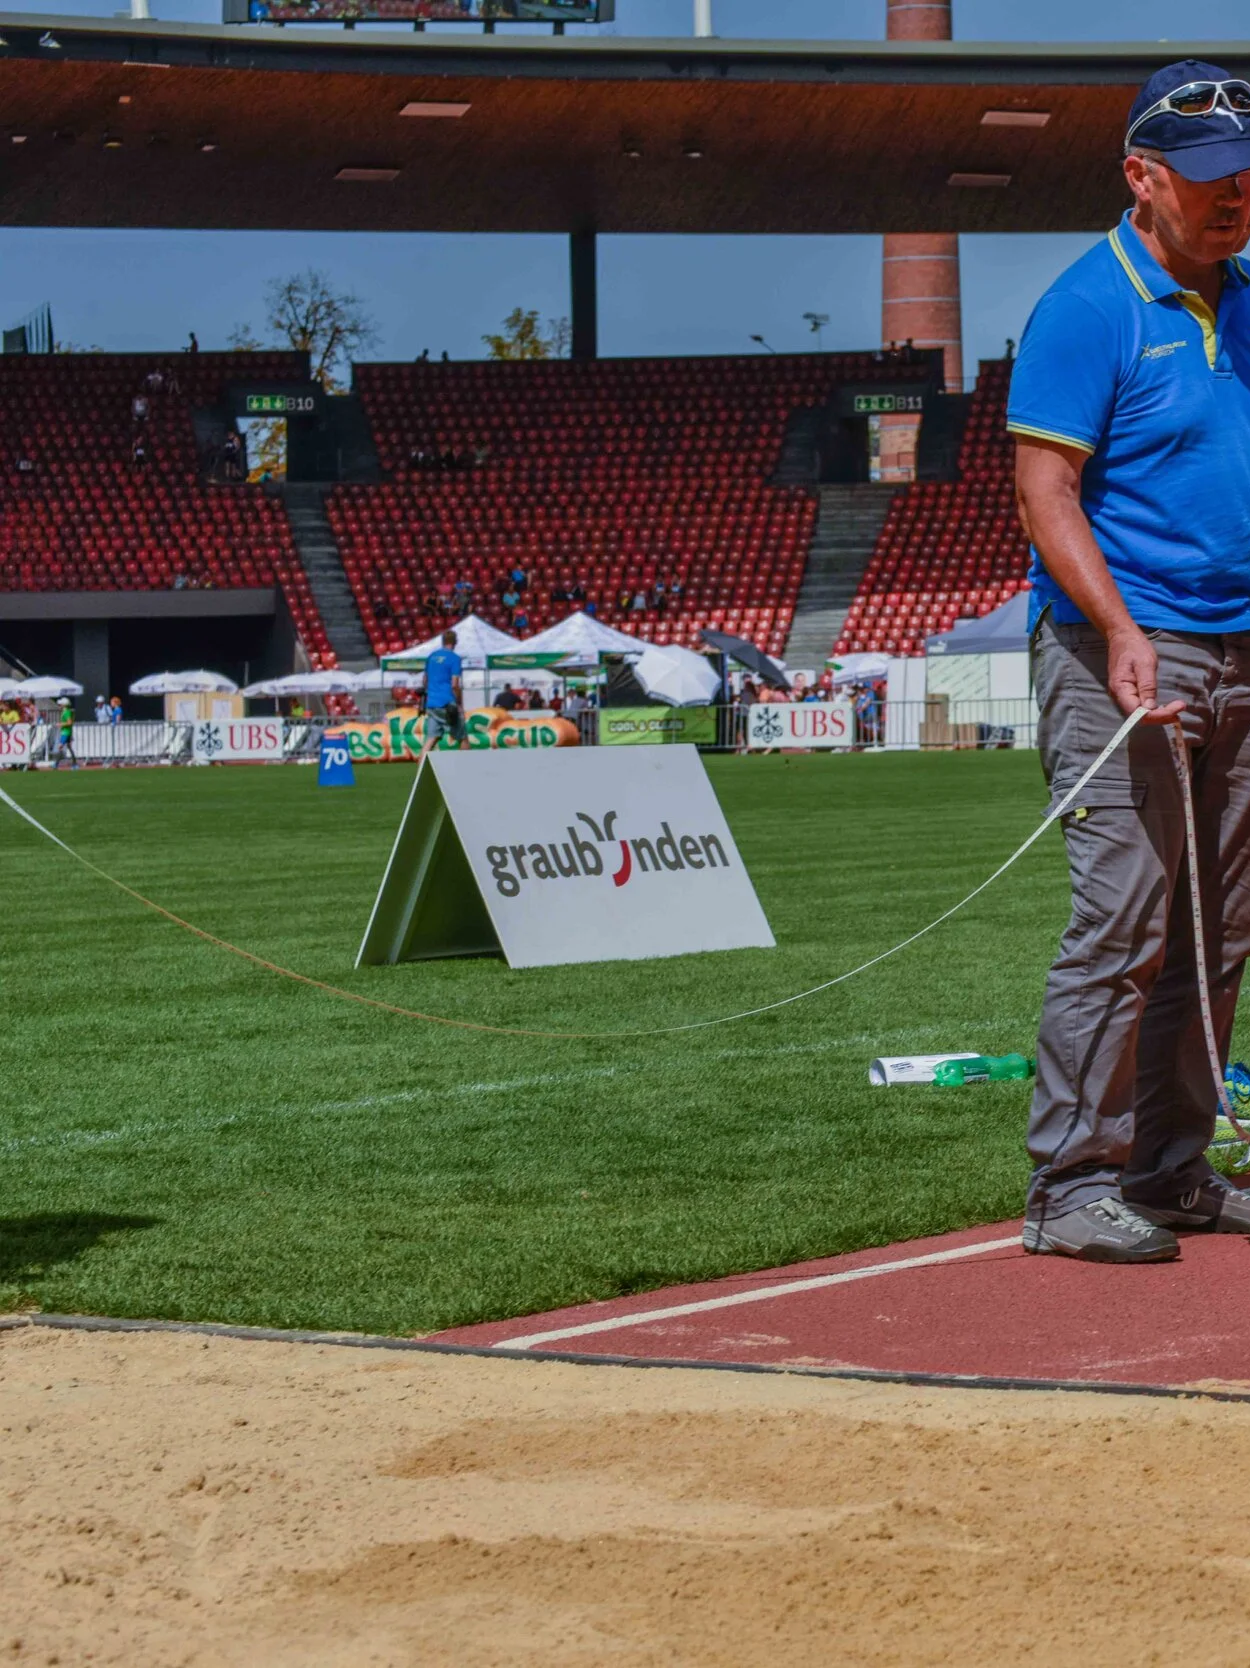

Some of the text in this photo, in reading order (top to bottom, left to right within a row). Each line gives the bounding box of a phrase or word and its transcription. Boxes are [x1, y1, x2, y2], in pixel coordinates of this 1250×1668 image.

[228, 723, 279, 751] UBS
[790, 709, 846, 738] UBS
[0, 729, 27, 757] BS
[348, 730, 385, 760] BS
[322, 746, 350, 770] 70
